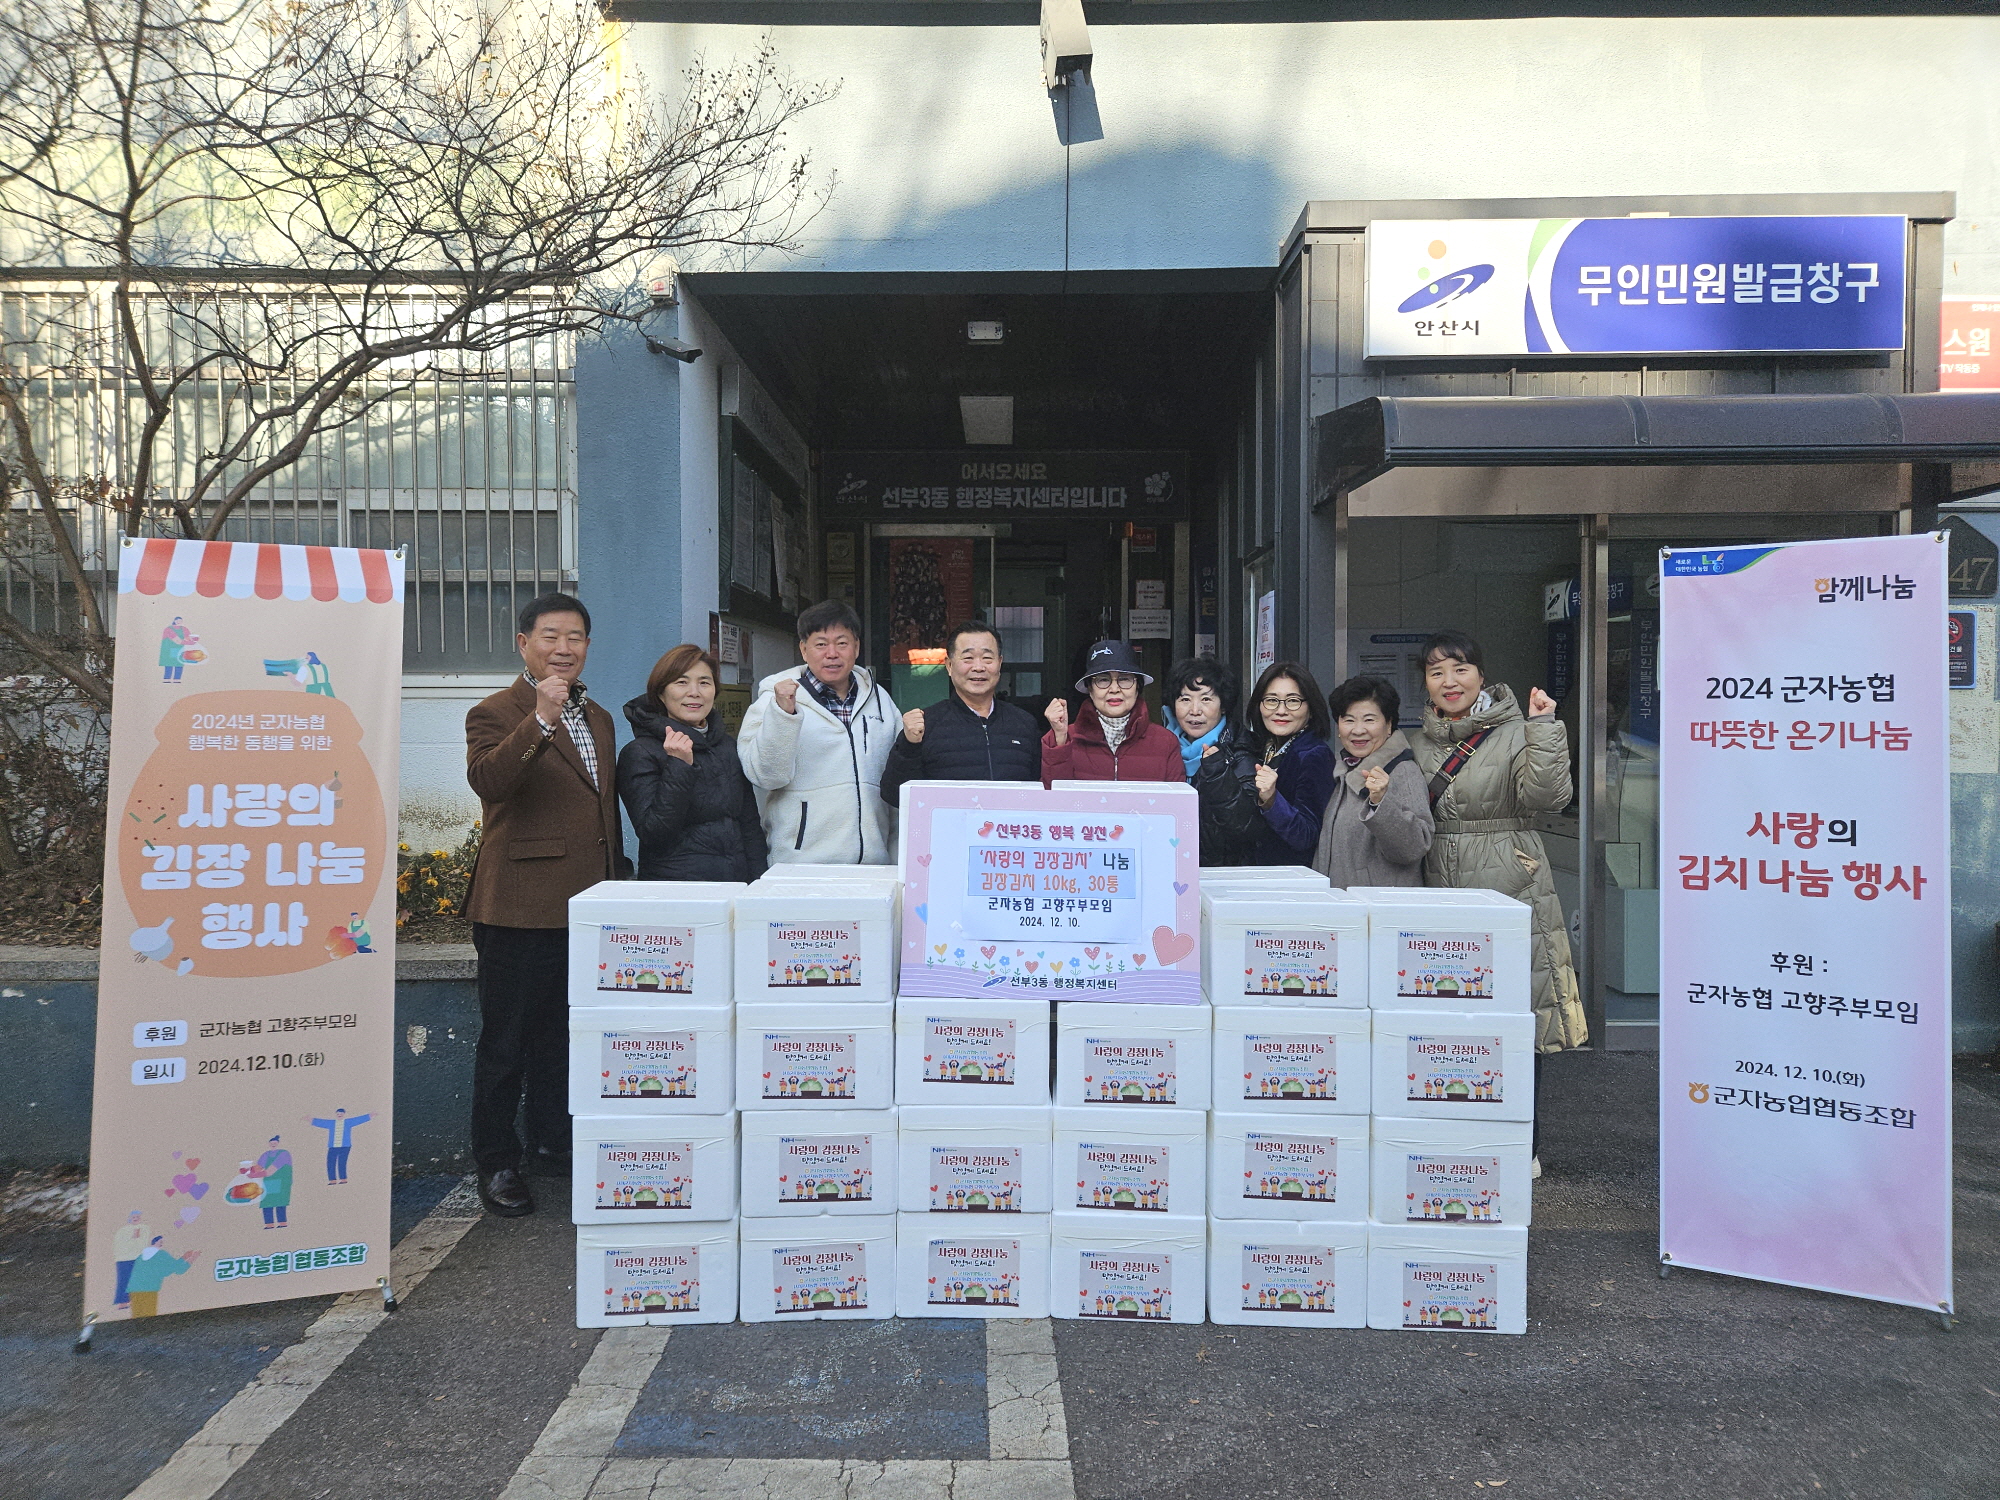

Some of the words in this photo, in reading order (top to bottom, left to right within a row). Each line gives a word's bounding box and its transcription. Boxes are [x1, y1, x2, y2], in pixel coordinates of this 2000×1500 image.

[1577, 262, 1880, 306] 무인민원발급창구
[1414, 320, 1480, 337] 안산시
[961, 463, 1047, 481] 어서오세요
[882, 486, 950, 509] 선부3동
[956, 486, 1127, 509] 행정복지센터입니다
[1706, 676, 1773, 700] 2024
[1780, 673, 1895, 703] 군자농협
[192, 714, 254, 730] 2024년
[259, 713, 325, 730] 군자농협
[188, 734, 239, 751] 행복한
[244, 734, 294, 751] 동행을
[299, 735, 333, 752] 위한
[1690, 720, 1779, 751] 따뜻한
[1786, 720, 1912, 752] 온기나눔
[177, 784, 336, 828] 사랑의
[996, 823, 1042, 840] 선부3동
[1049, 824, 1075, 840] 행복
[1081, 825, 1108, 841] 실천
[1746, 811, 1857, 850] 사랑의
[140, 843, 251, 890] 김장
[265, 840, 365, 886] 나눔
[1102, 852, 1130, 871] 나눔
[981, 872, 1035, 892] 김장김치
[1043, 874, 1081, 894] 10kg,
[1088, 875, 1119, 894] 30통
[1678, 855, 1748, 891] 김치
[1759, 859, 1834, 898] 나눔
[1841, 861, 1927, 901] 행사
[988, 897, 1035, 912] 군자농협
[1041, 898, 1113, 914] 고향주부모임
[200, 902, 309, 949] 행사
[1019, 916, 1045, 927] 2024.
[1050, 917, 1063, 928] 12.
[1068, 917, 1081, 928] 10.
[609, 934, 640, 944] 사랑의
[643, 934, 683, 946] 김장나눔
[777, 930, 807, 941] 사랑의
[810, 928, 849, 941] 김장나눔
[1254, 939, 1284, 949] 사랑의
[1287, 939, 1326, 951] 김장나눔
[1407, 940, 1437, 950] 사랑의
[1441, 941, 1481, 952] 김장나눔
[1770, 951, 1814, 976] 후원
[1010, 975, 1049, 989] 선부3동
[1053, 976, 1118, 991] 행정복지센터
[1687, 982, 1772, 1011] 군자농협
[1781, 990, 1919, 1025] 고향주부모임
[144, 1026, 177, 1043] 후원
[199, 1019, 263, 1038] 군자농협
[266, 1013, 358, 1033] 고향주부모임
[934, 1026, 963, 1036] 사랑의
[966, 1026, 1005, 1038] 김장나눔
[611, 1040, 641, 1051] 사랑의
[645, 1039, 685, 1052] 김장나눔
[772, 1042, 802, 1052] 사랑의
[805, 1041, 844, 1053] 김장나눔
[1093, 1046, 1123, 1057] 사랑의
[1126, 1047, 1165, 1058] 김장나눔
[1253, 1043, 1282, 1053] 사랑의
[1286, 1042, 1325, 1054] 김장나눔
[1417, 1044, 1447, 1054] 사랑의
[1451, 1044, 1491, 1056] 김장나눔
[142, 1063, 176, 1080] 일시
[198, 1052, 325, 1075] 2024.12.10.(화)
[1734, 1060, 1778, 1078] 2024.
[1783, 1066, 1807, 1081] 12.
[1813, 1067, 1866, 1089] 10.(화)
[1713, 1085, 1917, 1130] 군자농업협동조합
[607, 1151, 637, 1162] 사랑의
[641, 1150, 682, 1163] 김장나눔
[788, 1144, 818, 1156] 사랑의
[822, 1143, 861, 1156] 김장나눔
[1254, 1142, 1284, 1153] 사랑의
[1287, 1143, 1326, 1155] 김장나눔
[939, 1155, 969, 1166] 사랑의
[972, 1155, 1011, 1167] 김장나눔
[1086, 1152, 1116, 1162] 사랑의
[1119, 1153, 1158, 1165] 김장나눔
[1416, 1163, 1446, 1174] 사랑의
[1449, 1164, 1489, 1176] 김장나눔
[782, 1254, 812, 1266] 사랑의
[815, 1250, 854, 1265] 김장나눔
[937, 1247, 967, 1258] 사랑의
[970, 1248, 1009, 1259] 김장나눔
[1251, 1254, 1281, 1264] 사랑의
[1284, 1254, 1323, 1266] 김장나눔
[216, 1253, 290, 1280] 군자농협
[294, 1244, 367, 1270] 협동조합
[614, 1256, 644, 1269] 사랑의
[648, 1254, 688, 1268] 김장나눔
[1089, 1260, 1118, 1271] 사랑의
[1122, 1262, 1161, 1274] 김장나눔
[1412, 1271, 1442, 1281] 사랑의
[1446, 1272, 1486, 1284] 김장나눔
